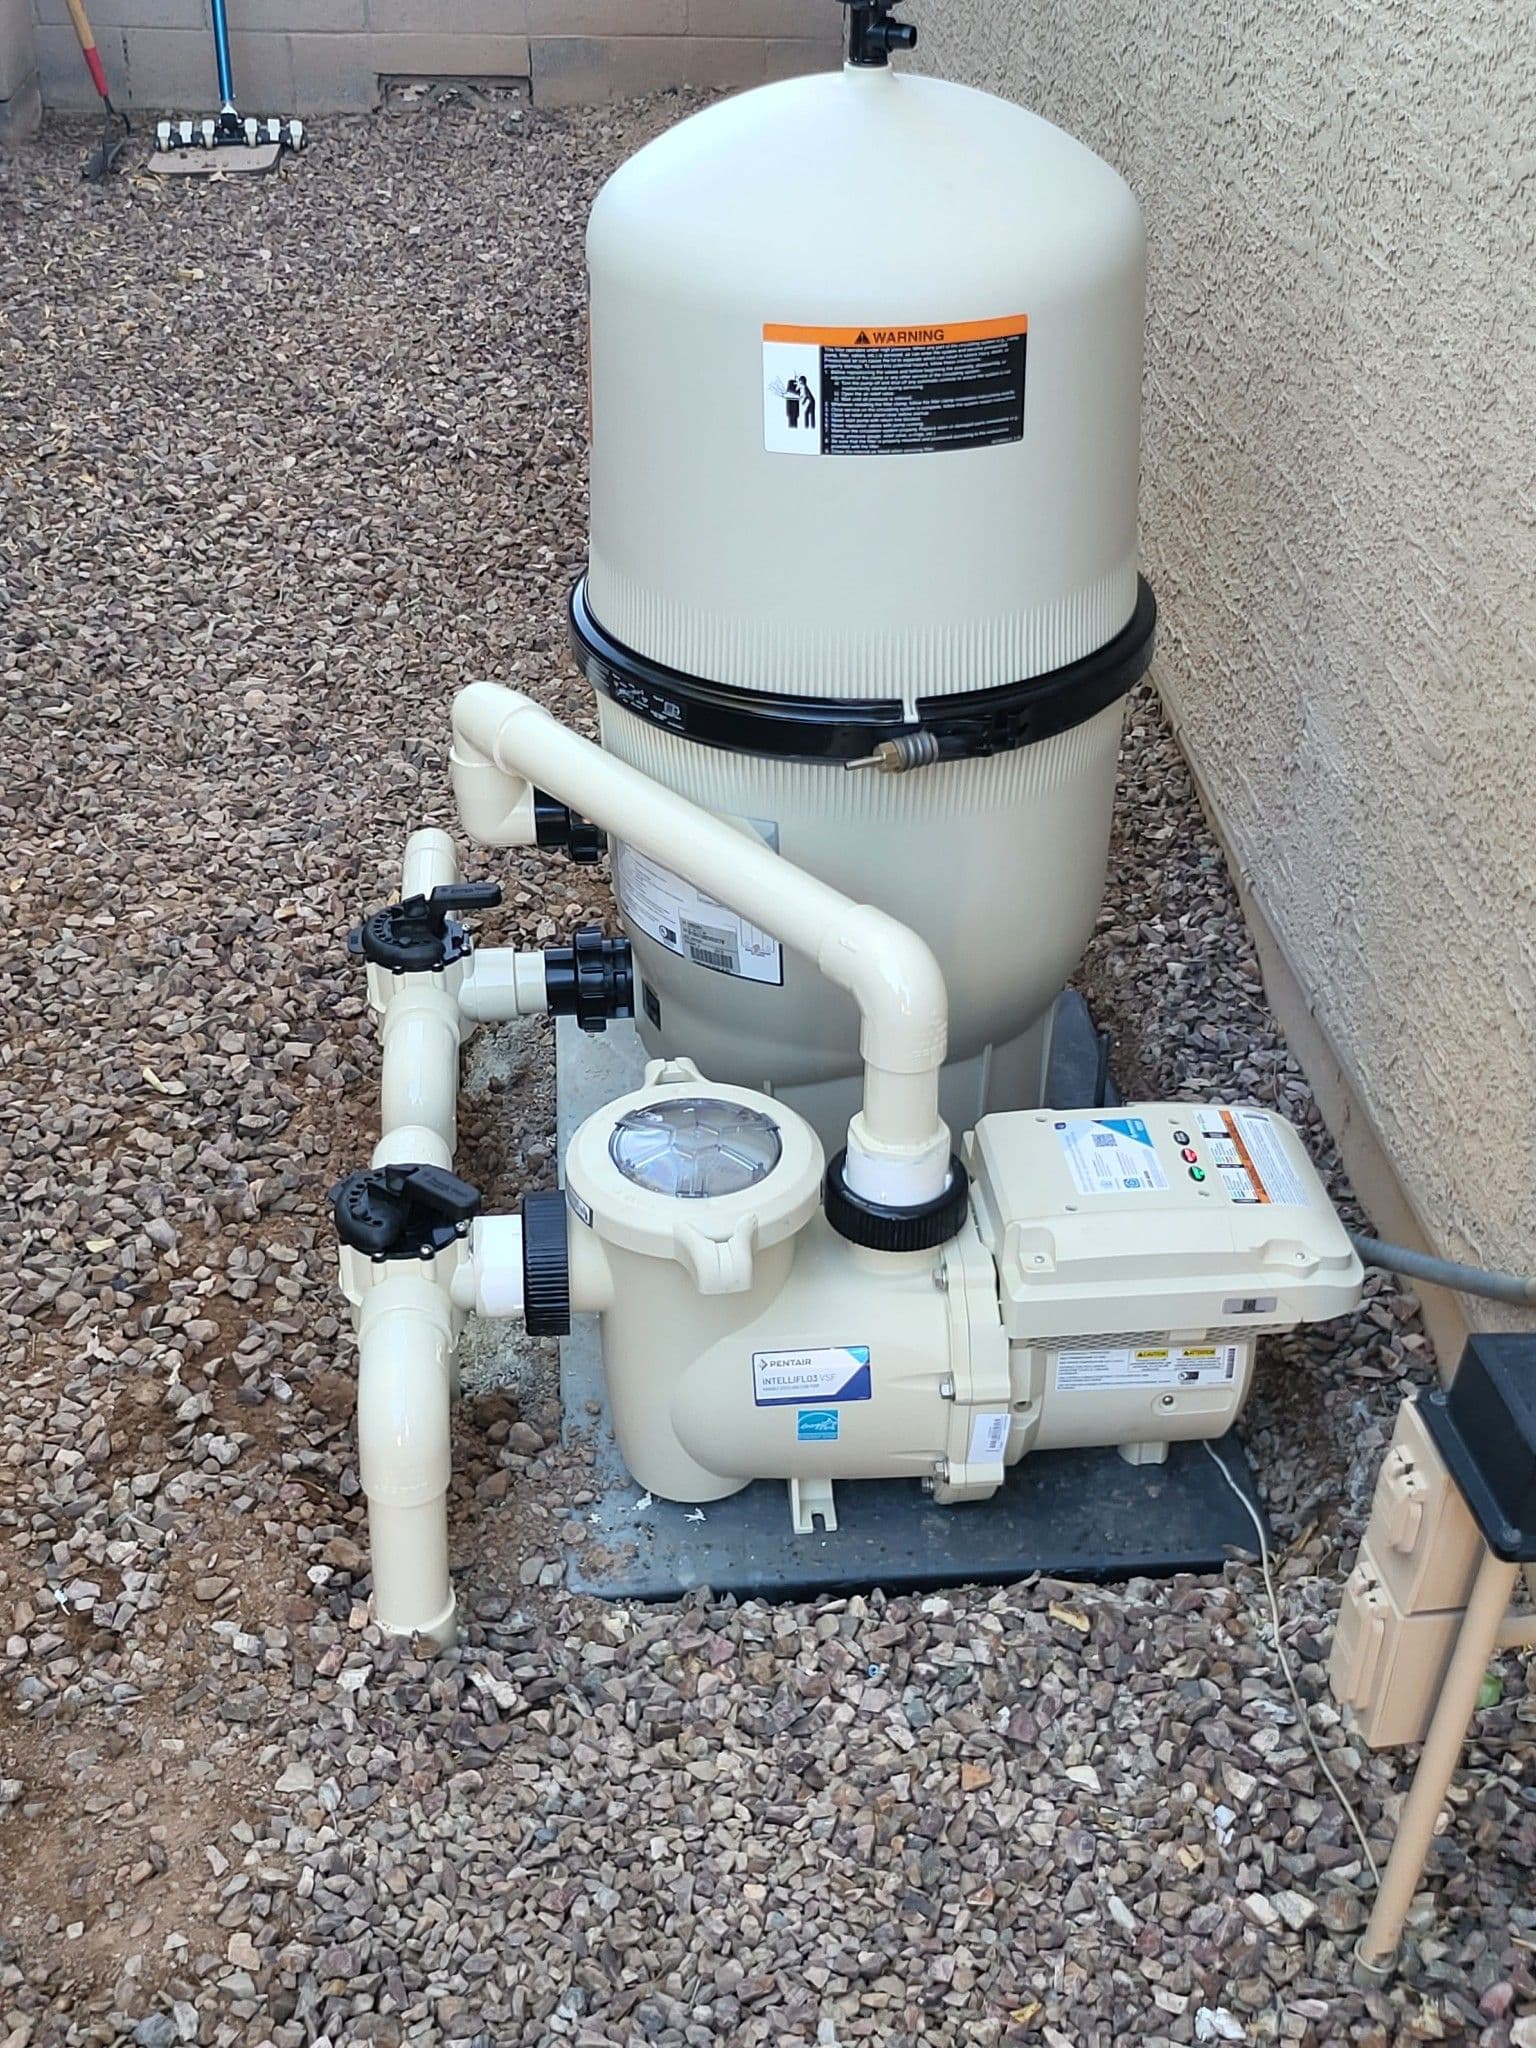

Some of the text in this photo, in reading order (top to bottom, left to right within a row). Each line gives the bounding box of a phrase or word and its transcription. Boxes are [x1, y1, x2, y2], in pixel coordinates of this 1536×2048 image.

[873, 329, 945, 344] WARNING
[769, 1358, 812, 1367] PENTAIR
[762, 1374, 818, 1385] INTELLIFLO3
